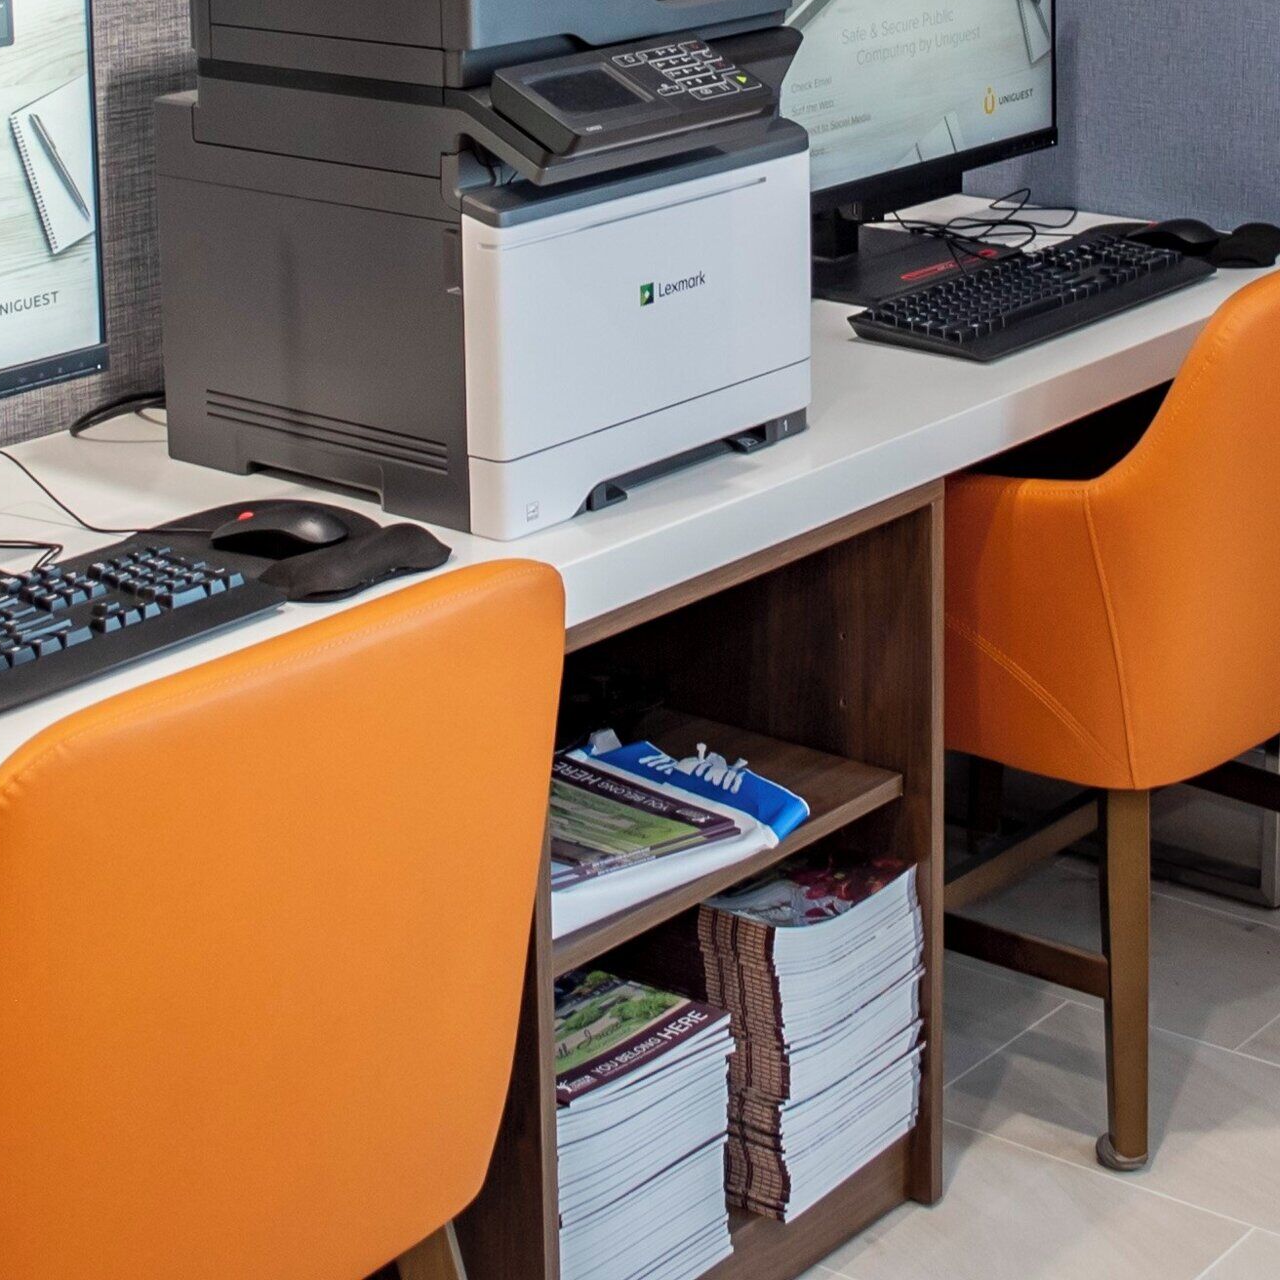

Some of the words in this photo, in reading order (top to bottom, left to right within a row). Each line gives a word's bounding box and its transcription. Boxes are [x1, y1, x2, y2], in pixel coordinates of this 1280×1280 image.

[841, 26, 868, 45] Safe
[870, 22, 878, 39] &
[881, 17, 919, 36] Secure
[922, 9, 954, 27] Public
[856, 42, 916, 65] Computing
[919, 37, 932, 53] by
[935, 26, 980, 48] Uniguest
[998, 87, 1034, 105] UNIGUEST
[658, 270, 706, 298] Lexmark
[554, 761, 600, 786] HERE
[598, 778, 646, 802] BELONG
[591, 1059, 619, 1075] YOU
[615, 1036, 661, 1065] BELONG
[657, 1009, 709, 1040] HERE
